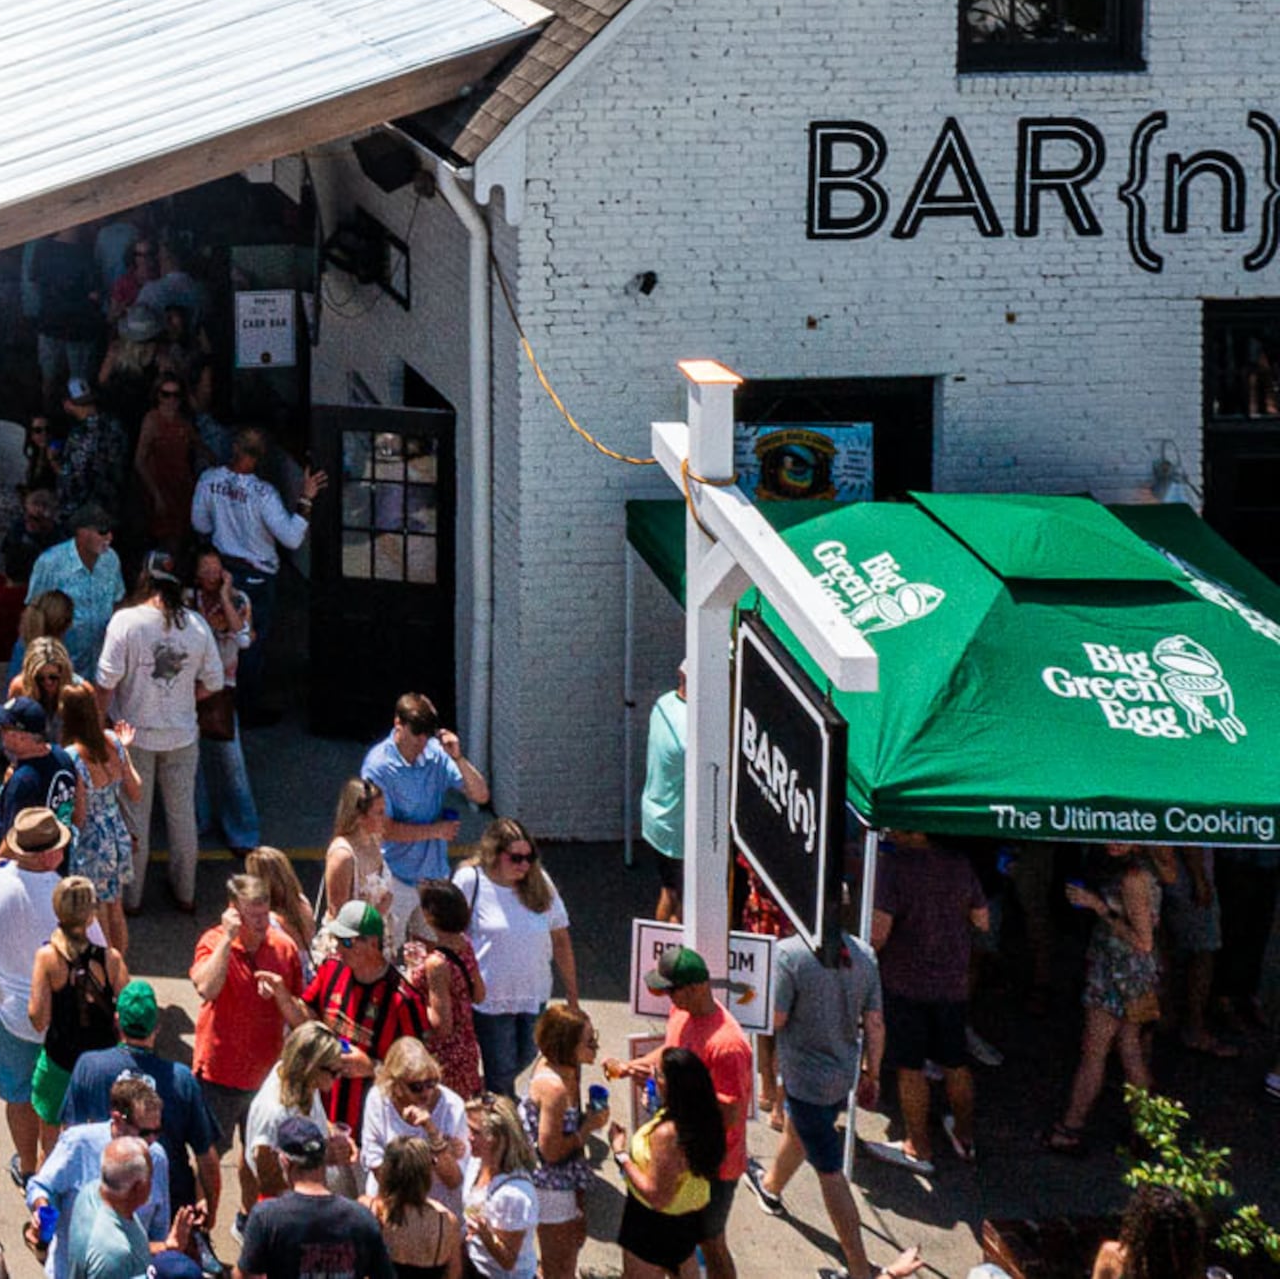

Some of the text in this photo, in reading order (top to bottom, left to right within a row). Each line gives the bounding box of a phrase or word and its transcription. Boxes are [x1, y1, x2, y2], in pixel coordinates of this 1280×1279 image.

[813, 540, 874, 604] Green
[859, 551, 907, 593] Big
[1082, 642, 1156, 680] Big
[1042, 666, 1168, 702] Green
[1100, 699, 1186, 738] Egg
[990, 805, 1275, 841] The Ultimate Cooking
